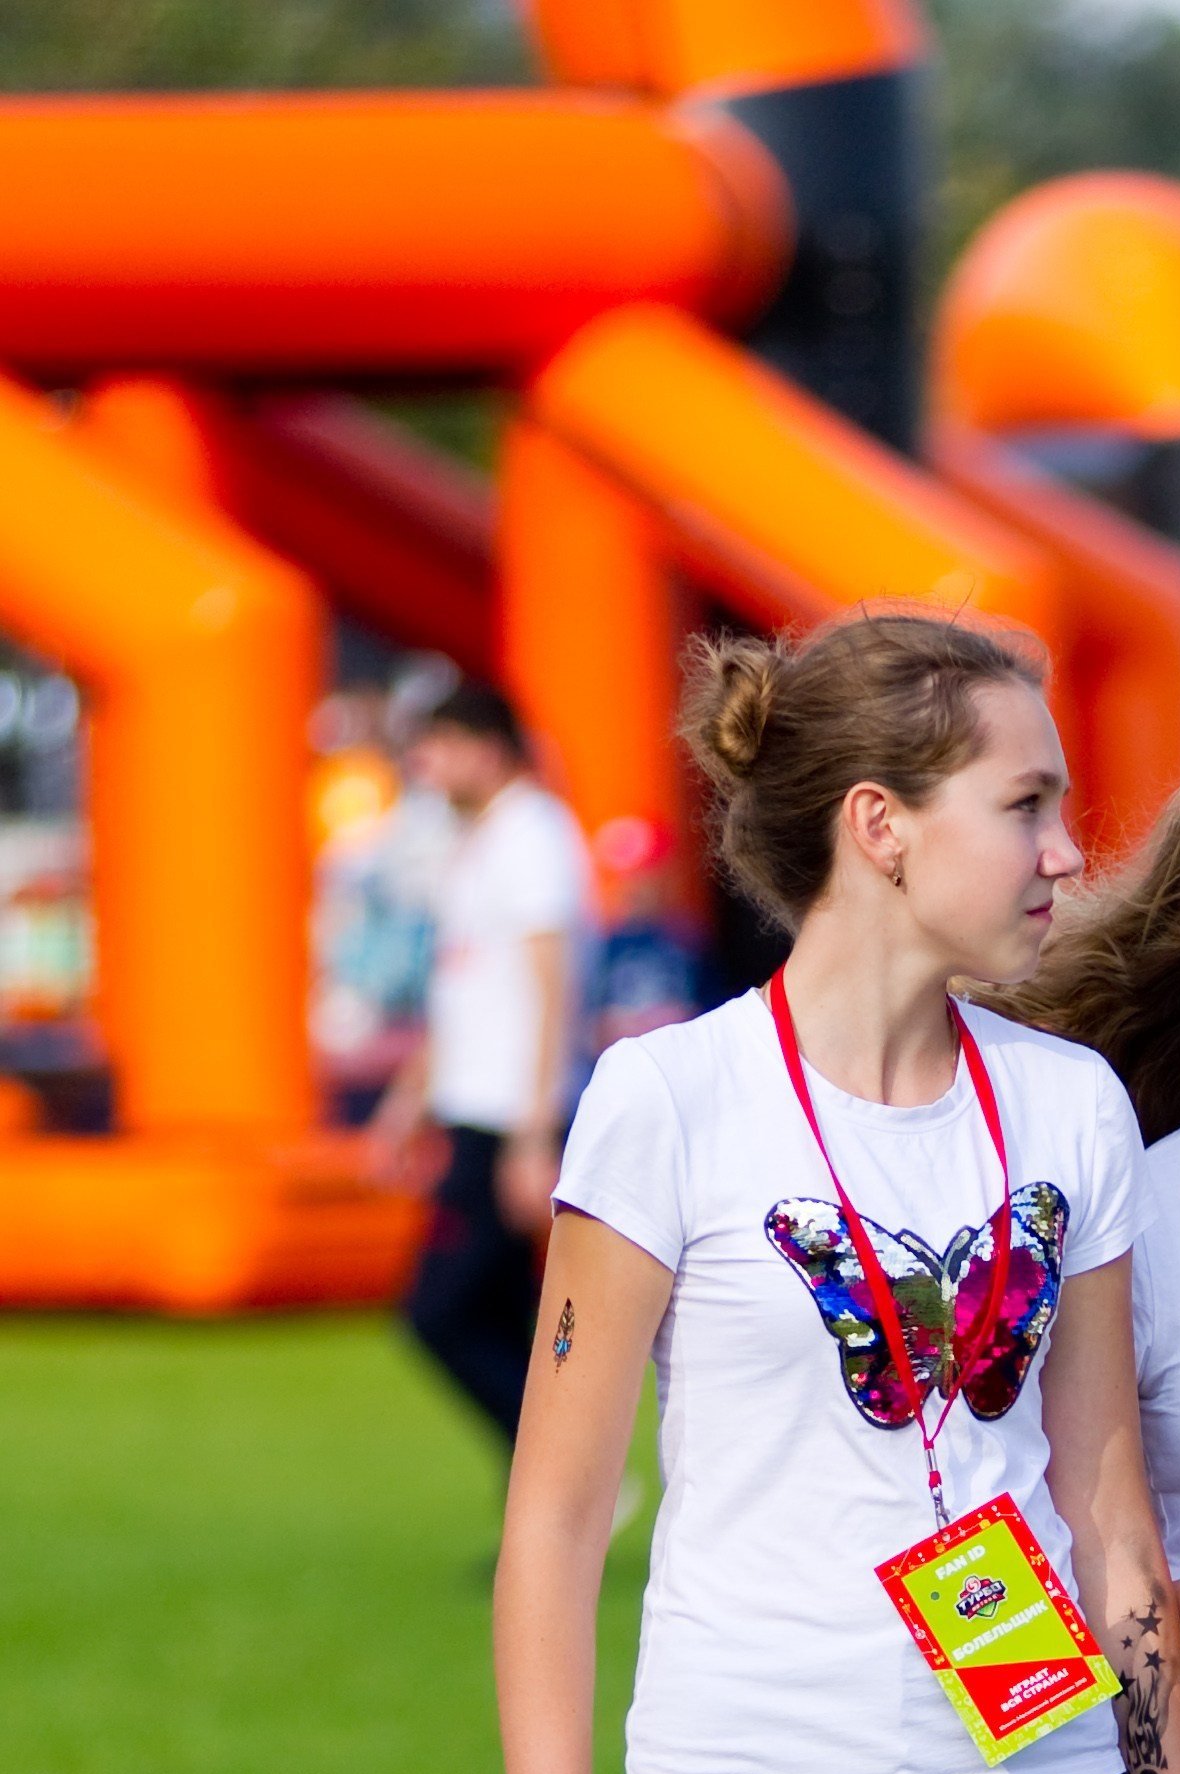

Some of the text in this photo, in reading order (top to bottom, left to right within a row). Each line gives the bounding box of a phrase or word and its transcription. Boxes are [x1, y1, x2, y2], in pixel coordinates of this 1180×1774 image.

[935, 1544, 986, 1580] FAN ID
[959, 1582, 1002, 1610] ТУРБО
[952, 1599, 1048, 1662] БОЛЕЛЬЩИК
[1000, 1695, 1023, 1712] ВСЯ
[1023, 1667, 1069, 1699] СТРАНА!
[1009, 1667, 1049, 1696] ИГРАЕТ
